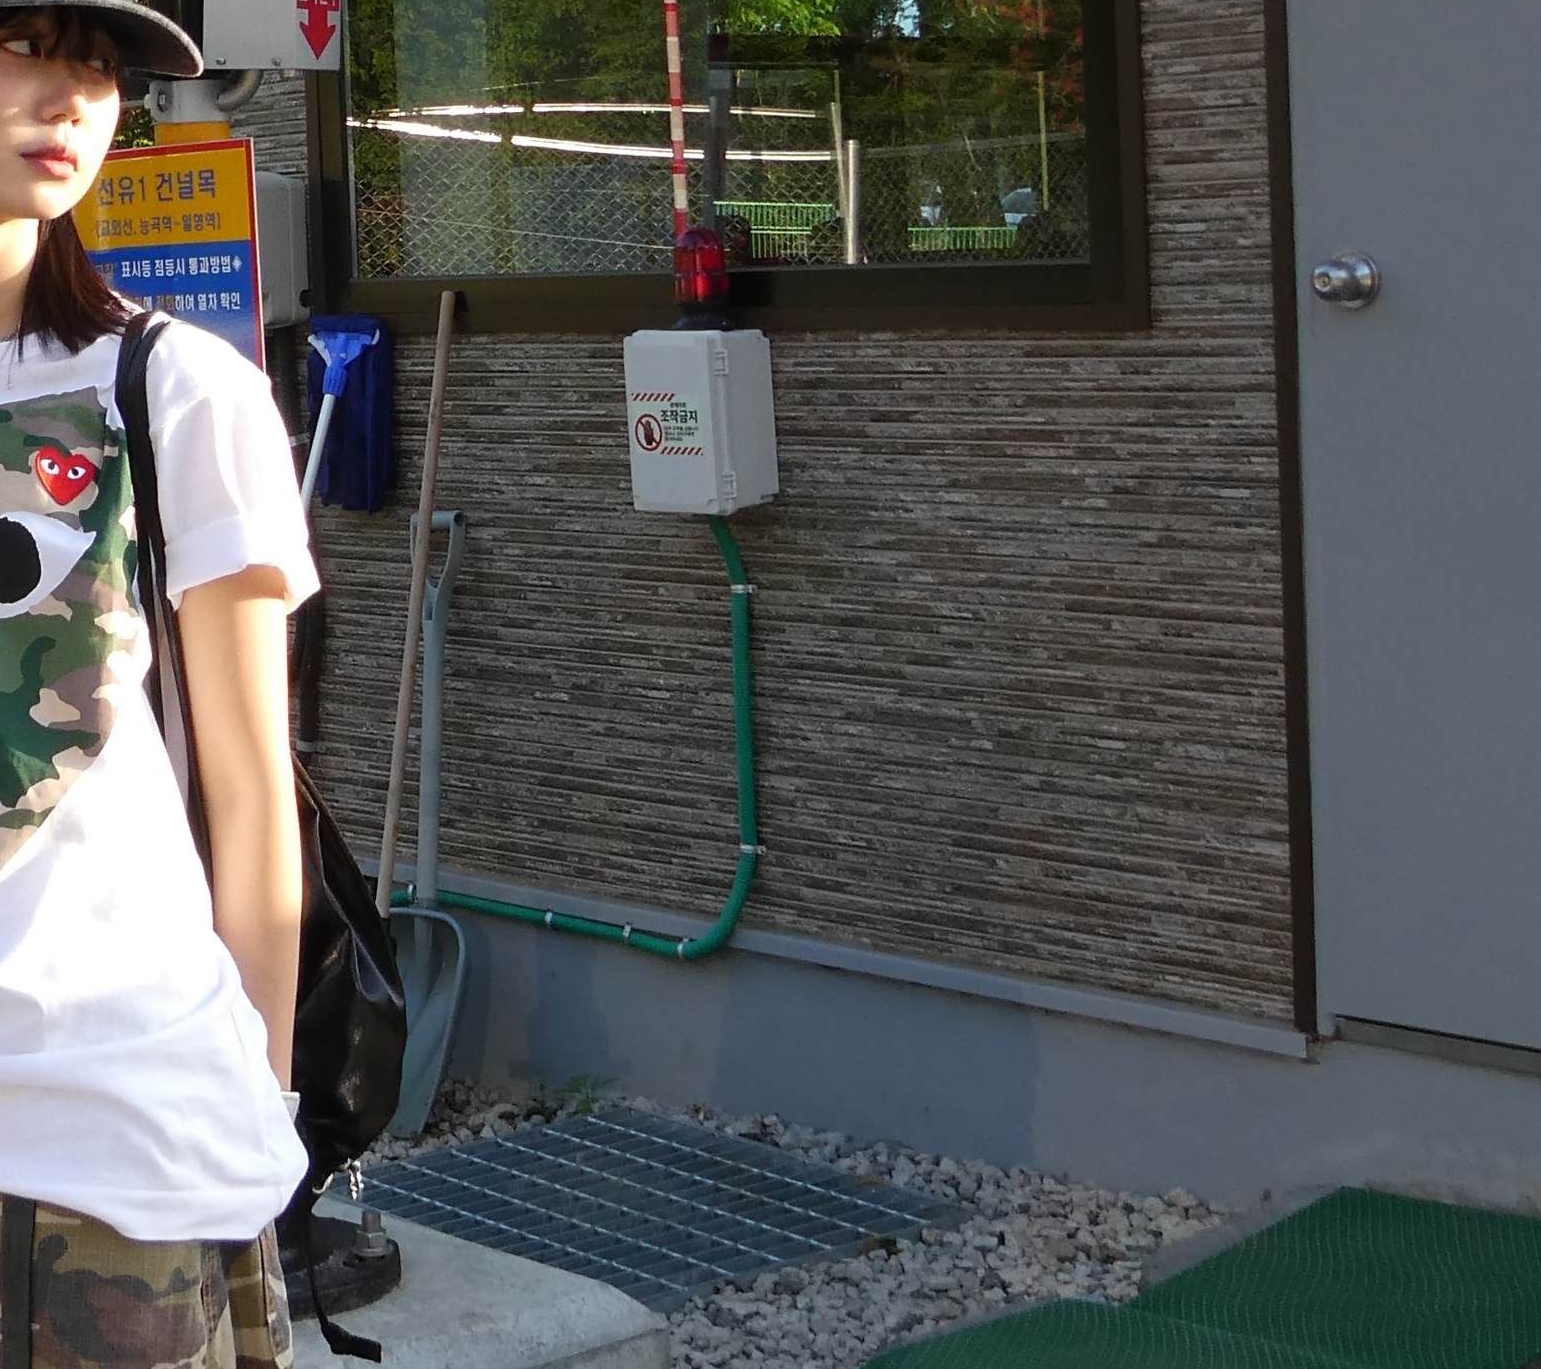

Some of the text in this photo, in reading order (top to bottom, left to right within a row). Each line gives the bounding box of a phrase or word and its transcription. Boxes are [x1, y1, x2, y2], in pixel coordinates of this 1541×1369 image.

[98, 169, 216, 206] 선유1 건널목
[121, 260, 151, 278] 표시등
[154, 258, 185, 277] 점등시
[197, 293, 217, 312] 열차
[220, 292, 240, 311] 확인
[660, 409, 698, 424] 조작금지
